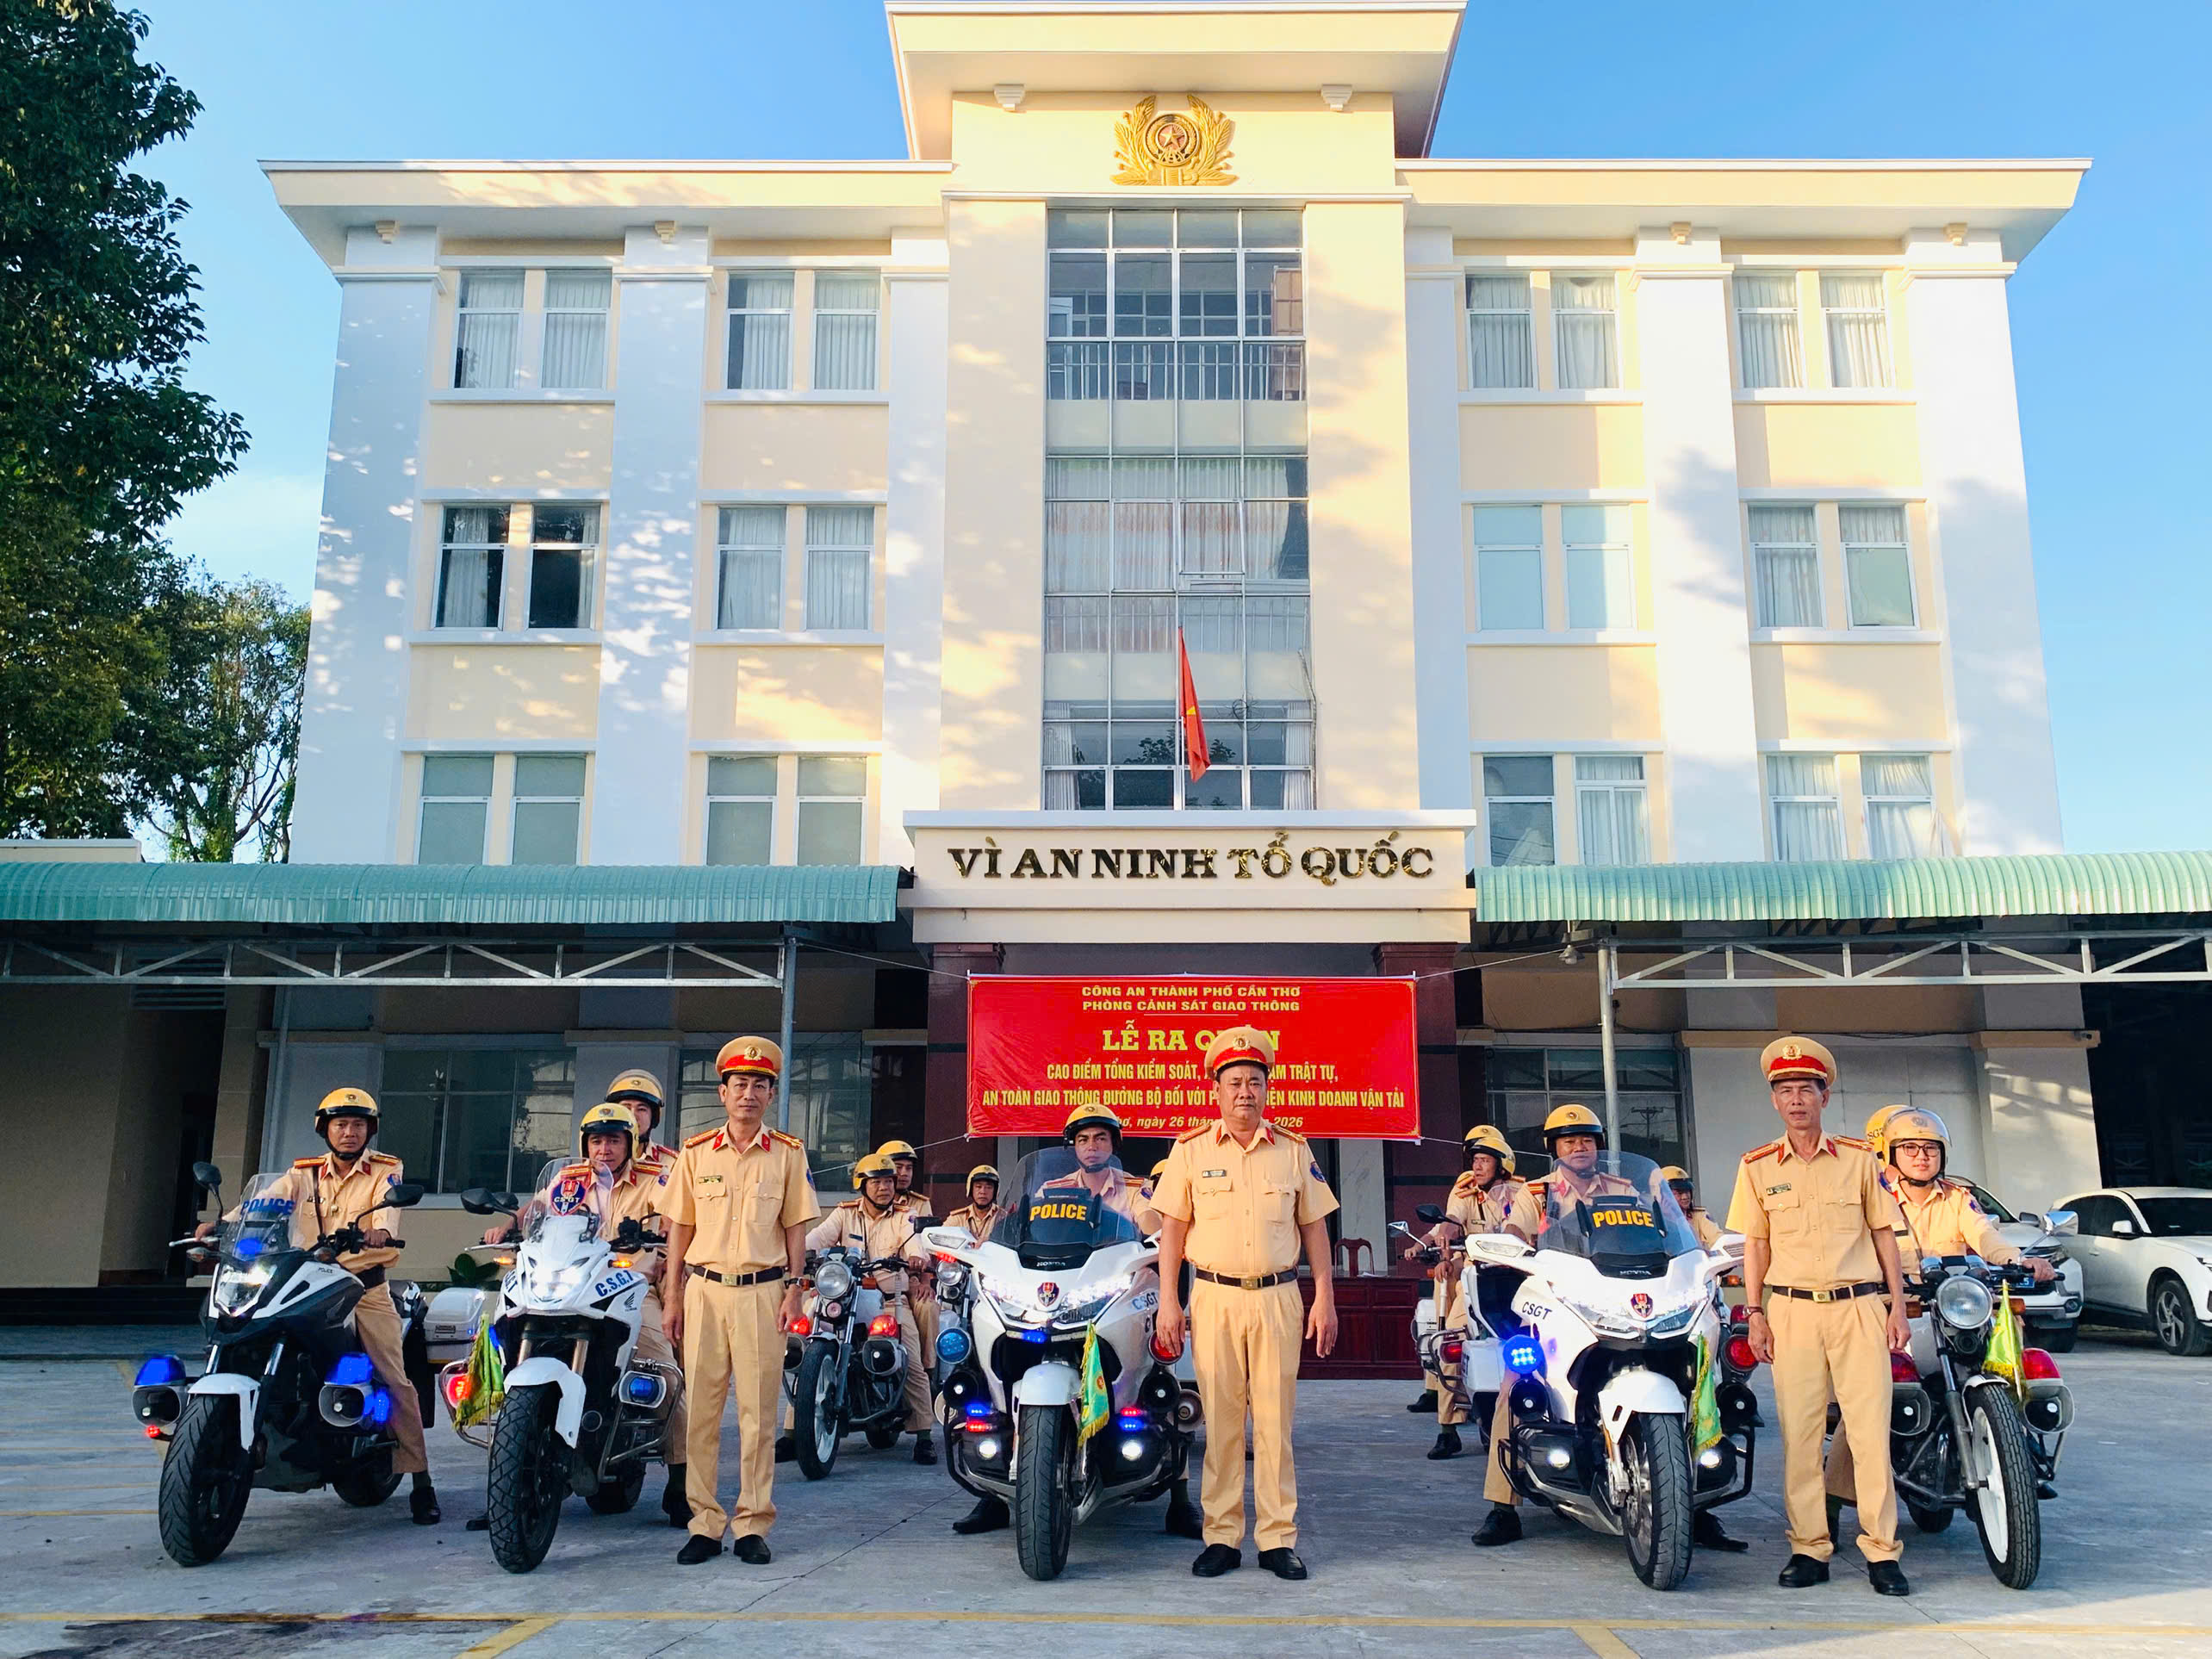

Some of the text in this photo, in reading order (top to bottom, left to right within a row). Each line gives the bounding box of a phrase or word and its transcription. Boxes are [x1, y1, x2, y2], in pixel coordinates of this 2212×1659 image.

[947, 830, 1433, 886] VÌ AN NINH TỔ QUỐC
[1082, 984, 1301, 997] CÔNG AN THÀNH PHỐ CẦN THƠ
[1083, 999, 1300, 1011] PHÒNG CẢNH SÁT GIAO THÔNG
[1103, 1019, 1281, 1052] LỄ RA QN
[1047, 1064, 1070, 1079] CAO
[1072, 1057, 1102, 1079] ĐIỂM
[1104, 1058, 1134, 1079] TỔNG
[1137, 1058, 1165, 1079] KIỂM
[1169, 1060, 1202, 1082] SOÁT,
[1289, 1060, 1317, 1084] TRẬT
[1320, 1064, 1339, 1084] TỰ,
[983, 1090, 998, 1106] AN
[1001, 1086, 1031, 1106] TOÀN
[1034, 1090, 1060, 1106] GIAO
[1063, 1085, 1101, 1106] THÔNG
[1103, 1085, 1144, 1106] ĐƯỜNG
[1146, 1086, 1162, 1109] BỘ
[1165, 1084, 1184, 1106] ĐỐI
[1187, 1086, 1206, 1106] VỚI
[1266, 1086, 1285, 1109] IỆN
[1288, 1090, 1316, 1107] KINH
[1318, 1090, 1358, 1107] DOANH
[1360, 1088, 1383, 1110] VẬN
[1385, 1086, 1405, 1108] TẢI
[1137, 1116, 1166, 1129] ngày
[1169, 1115, 1184, 1128] 26
[1274, 1116, 1304, 1128] 2026
[240, 1197, 296, 1216] POLICE
[1029, 1203, 1088, 1221] POLICE
[1592, 1209, 1655, 1228] POLICE
[1132, 1292, 1159, 1310] CSGT
[1522, 1302, 1553, 1320] CSGT
